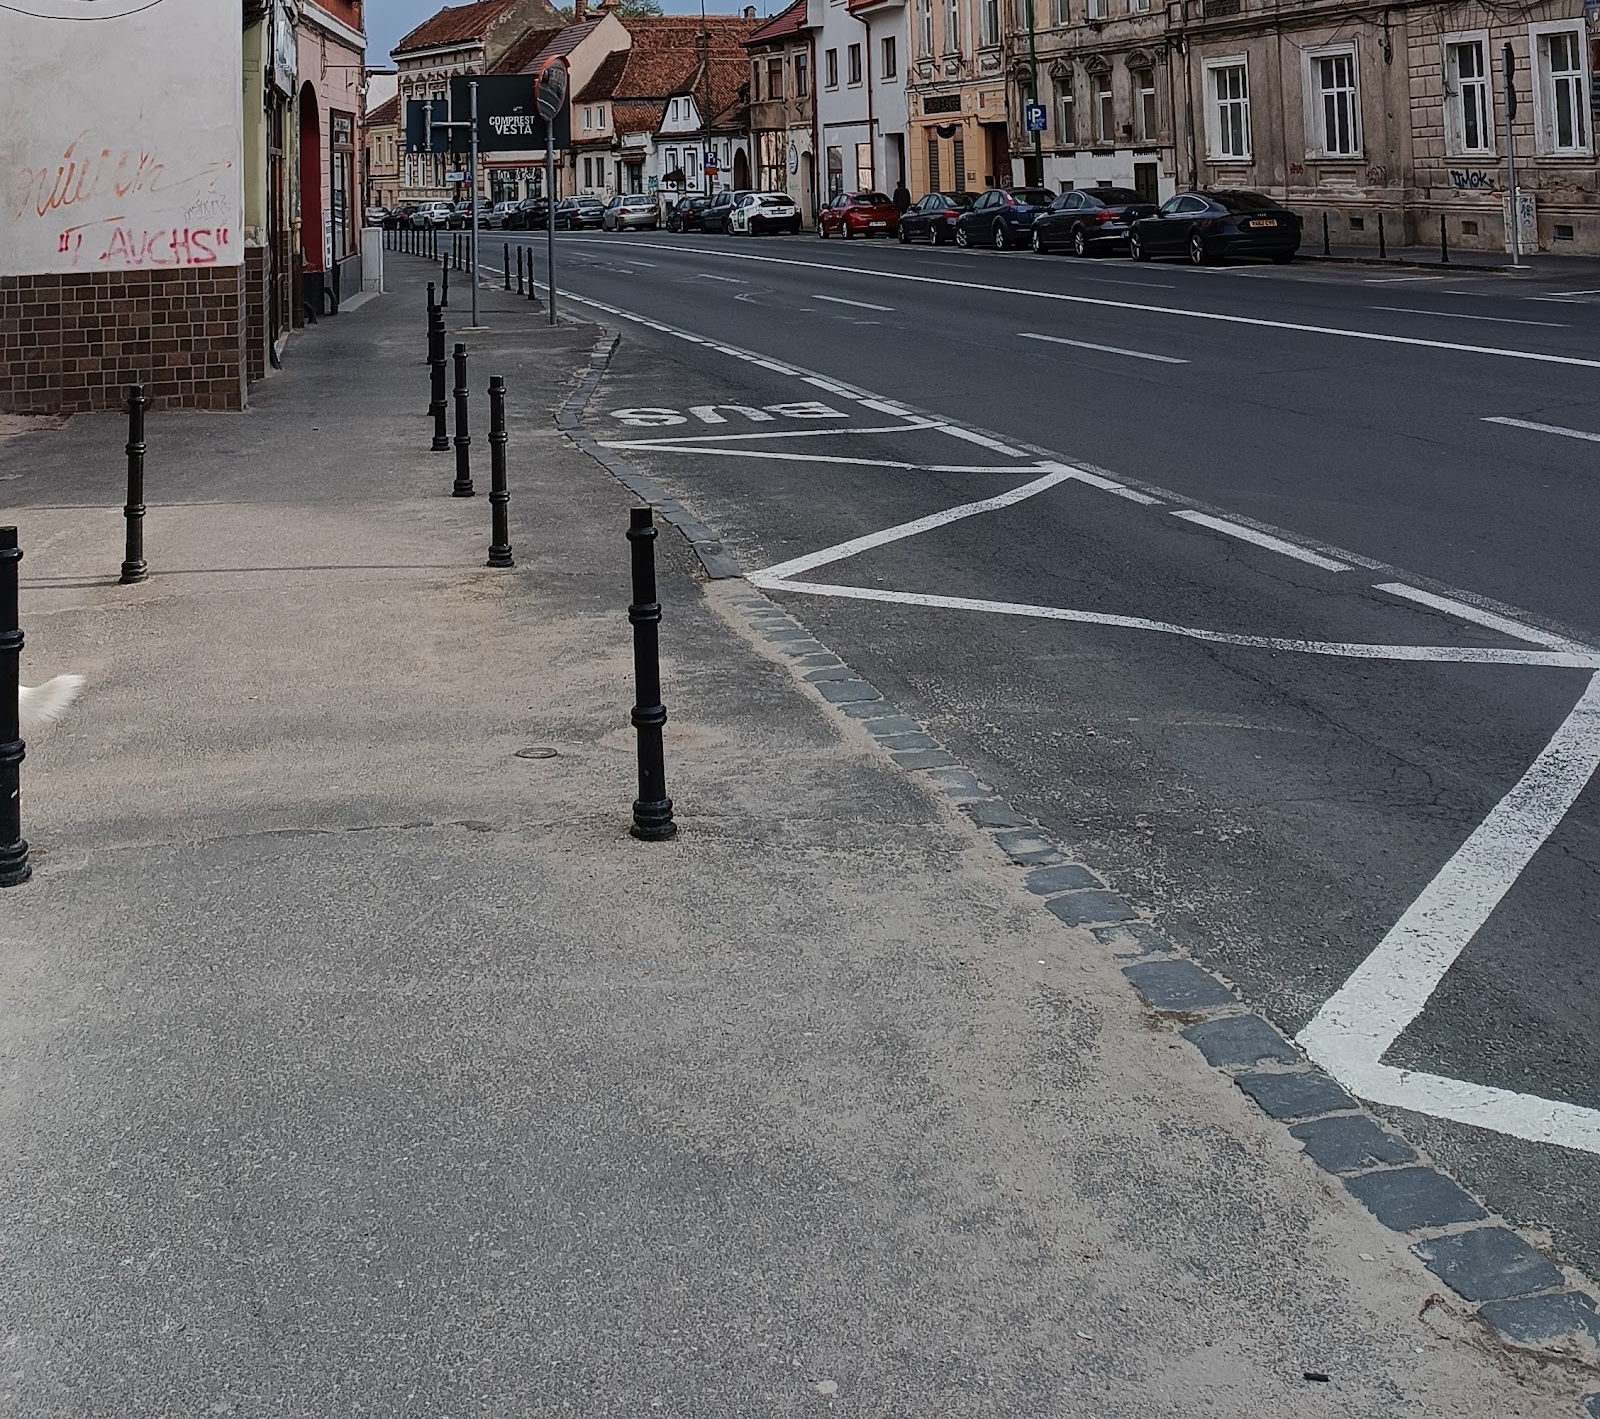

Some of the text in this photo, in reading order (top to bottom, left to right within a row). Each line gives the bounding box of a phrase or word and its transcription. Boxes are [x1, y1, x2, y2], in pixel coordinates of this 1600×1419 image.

[489, 115, 536, 126] COMPREST
[494, 124, 533, 135] VESTA
[610, 401, 850, 427] BUS
